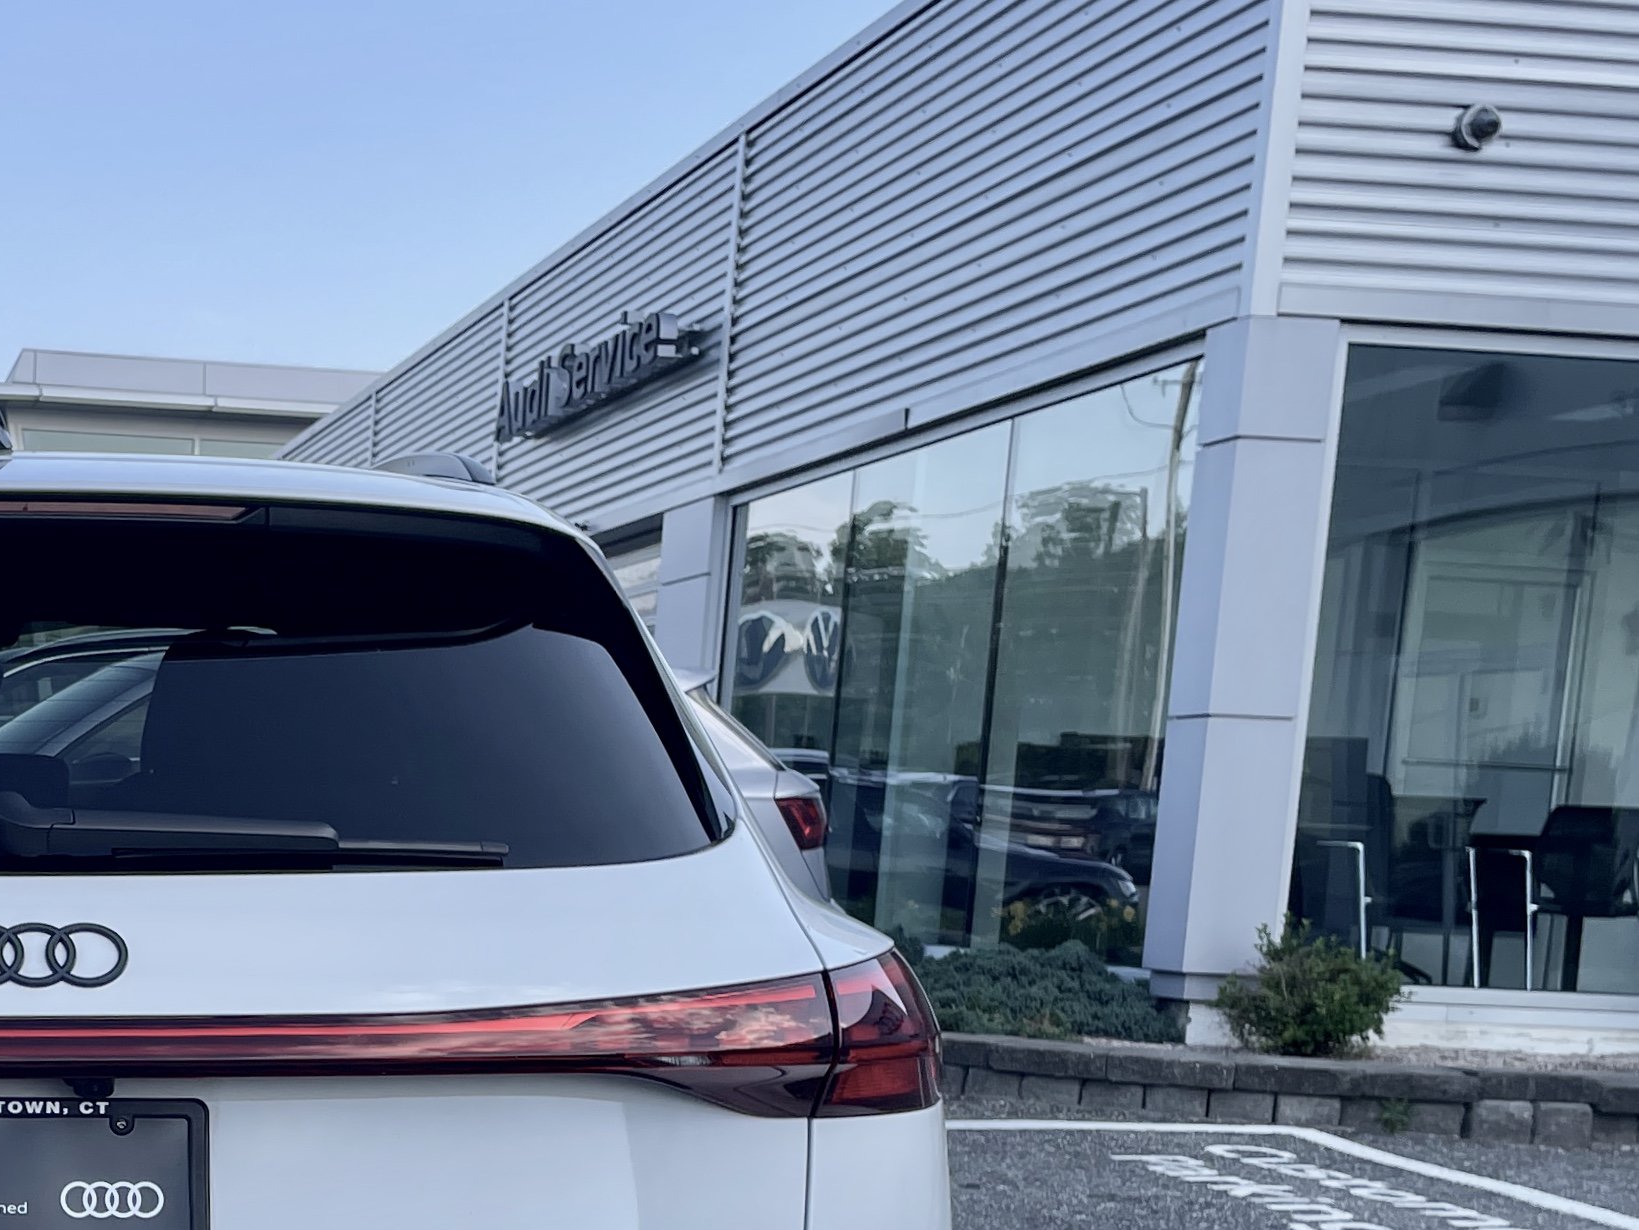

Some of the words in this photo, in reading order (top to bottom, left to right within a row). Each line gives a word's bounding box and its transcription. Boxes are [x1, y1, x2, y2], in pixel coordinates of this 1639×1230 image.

[495, 356, 552, 443] Audi
[557, 311, 663, 408] Service
[79, 1101, 109, 1114] CT
